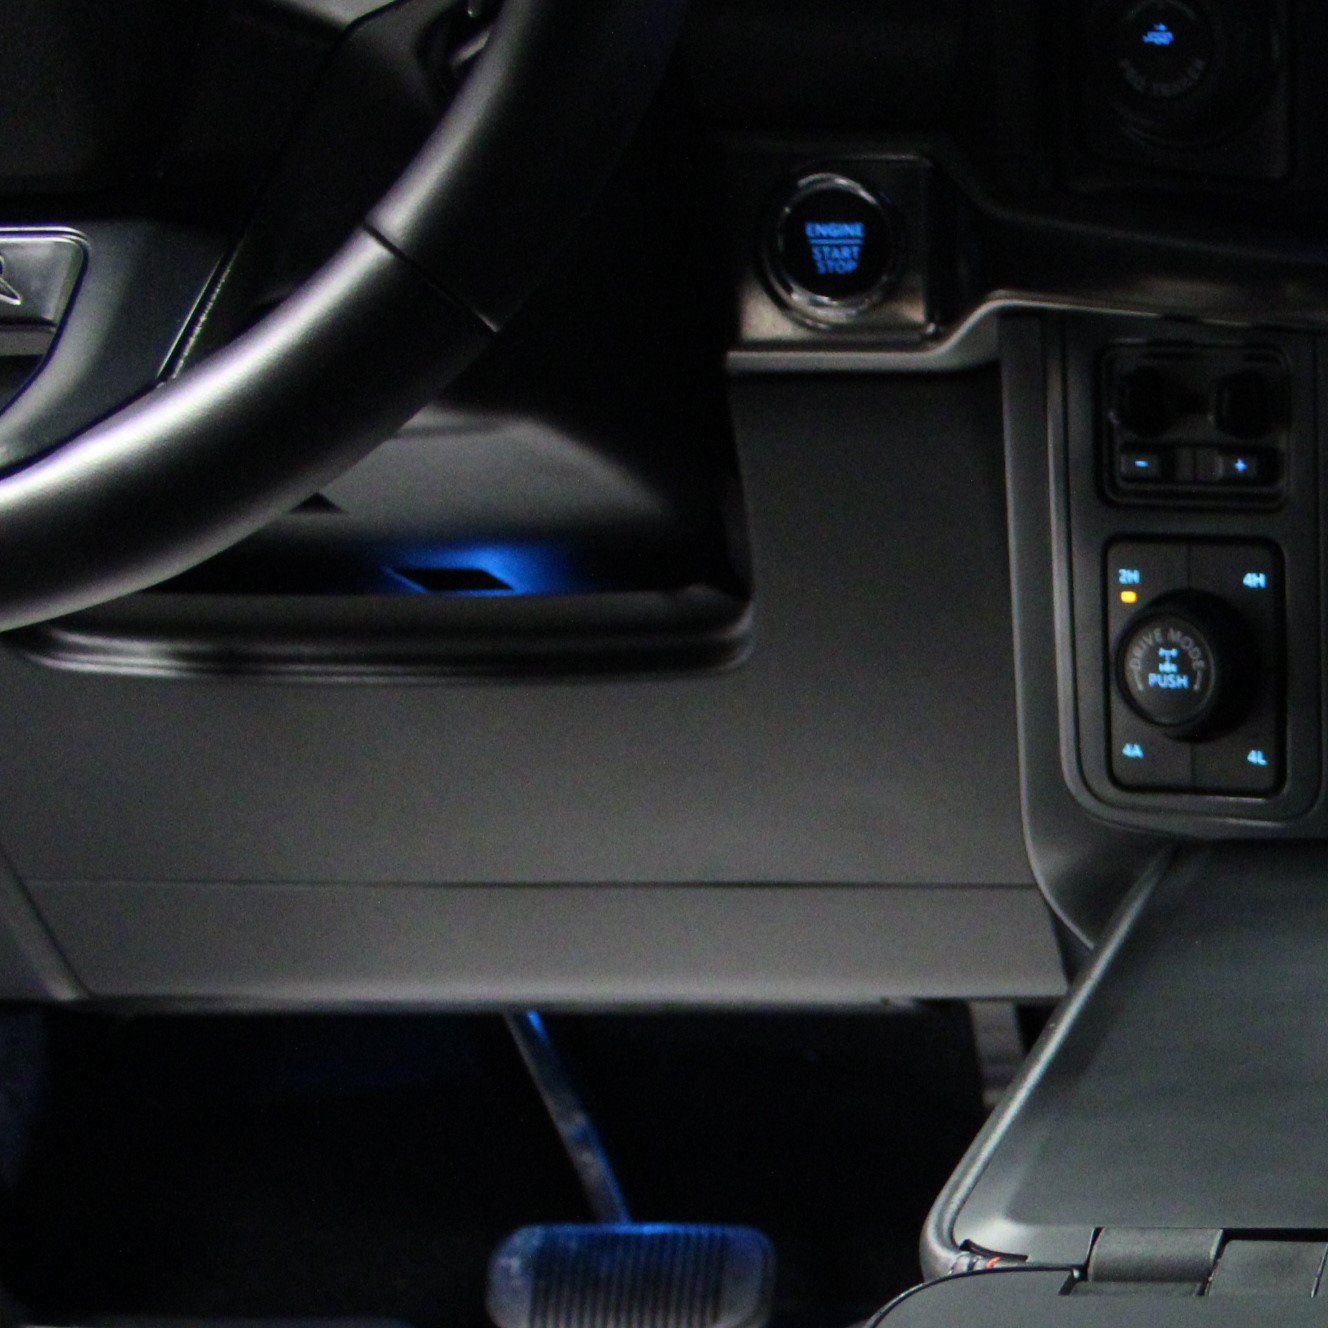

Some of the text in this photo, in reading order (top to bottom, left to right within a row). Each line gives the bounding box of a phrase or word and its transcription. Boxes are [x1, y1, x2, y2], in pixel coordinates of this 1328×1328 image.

[806, 223, 863, 237] ENGINE
[813, 246, 860, 259] START
[817, 259, 858, 274] STOP
[1118, 569, 1140, 584] 2H
[1242, 573, 1267, 588] 4H
[1148, 672, 1189, 689] PUSH
[1122, 743, 1144, 758] 4A
[1247, 750, 1268, 766] 4L
